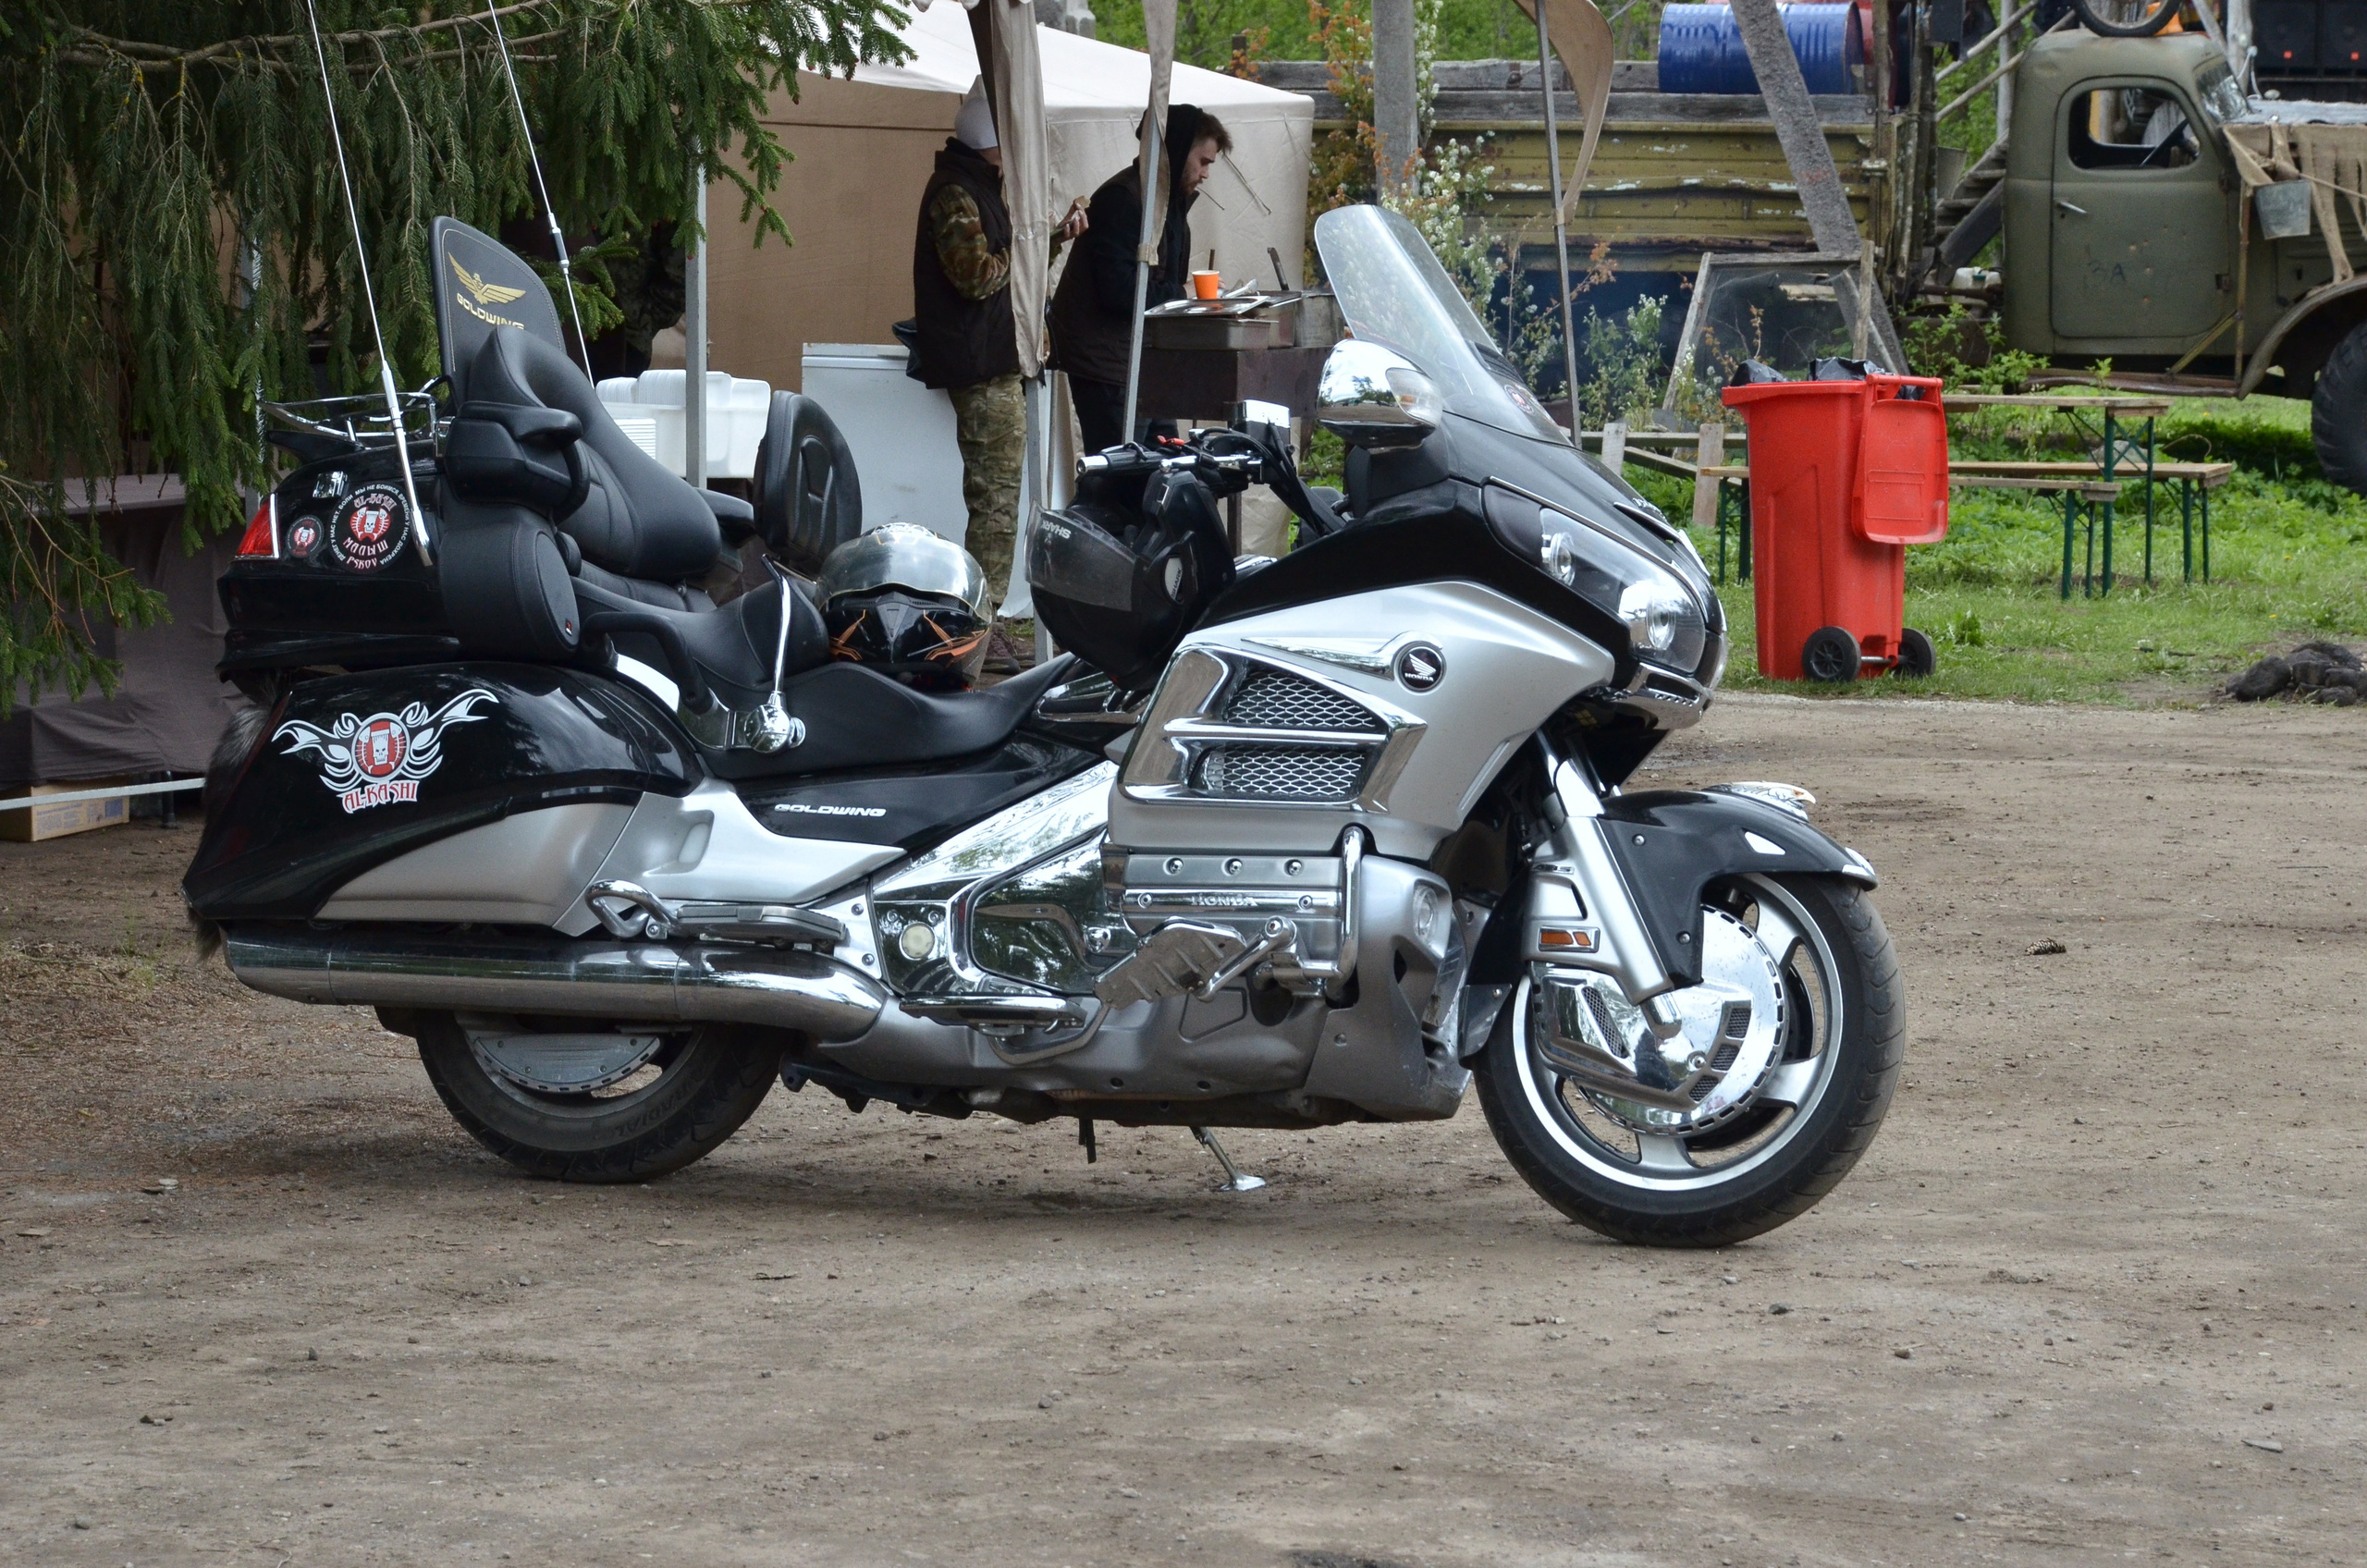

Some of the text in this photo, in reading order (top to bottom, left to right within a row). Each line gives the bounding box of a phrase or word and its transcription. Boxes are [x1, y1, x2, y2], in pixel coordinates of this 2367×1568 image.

[338, 495, 353, 509] БОЛИ
[355, 487, 365, 496] МЫ
[1040, 520, 1072, 540] SHARK
[346, 556, 378, 570] PSKOV
[1404, 672, 1435, 682] HONDA
[343, 781, 418, 813] AL-KASHI
[774, 803, 887, 817] GOLDWING
[1191, 893, 1258, 907] HONDA
